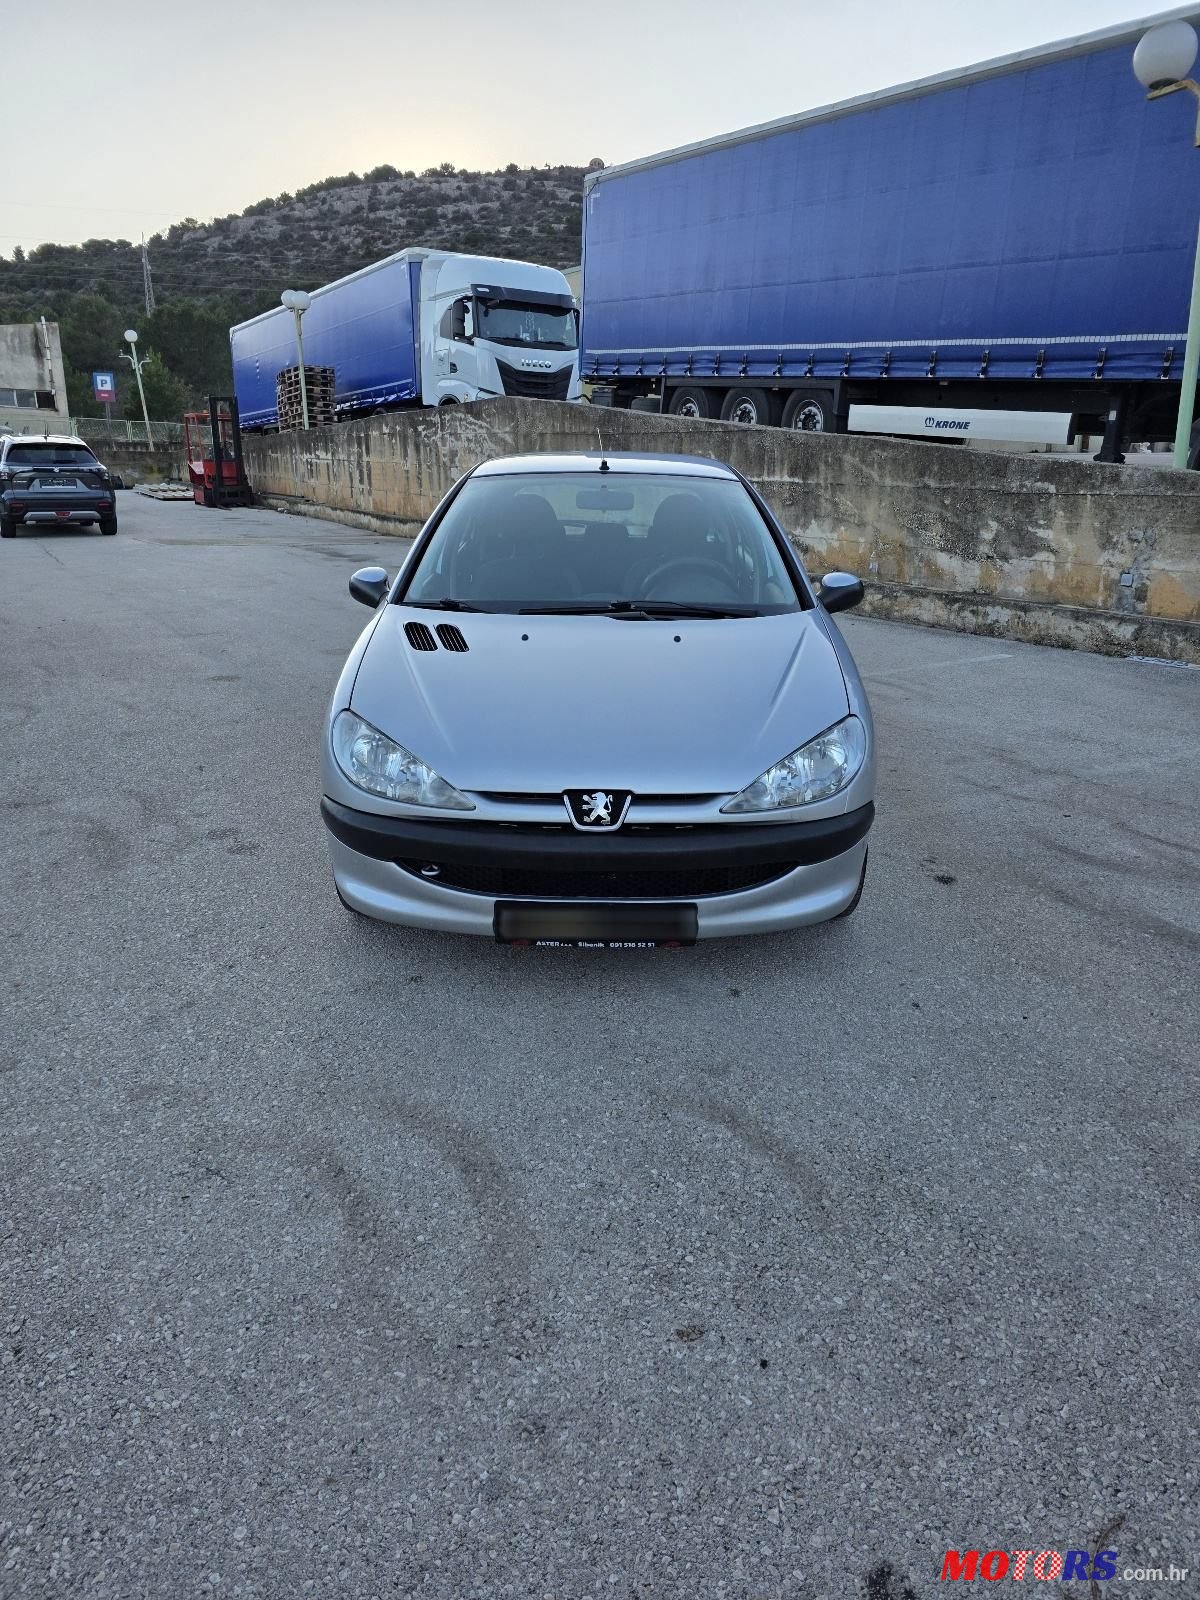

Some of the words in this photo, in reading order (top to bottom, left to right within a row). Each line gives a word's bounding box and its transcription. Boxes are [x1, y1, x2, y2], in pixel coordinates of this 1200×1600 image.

[521, 359, 552, 368] IVECO
[100, 379, 108, 388] P
[935, 420, 971, 430] KRONE
